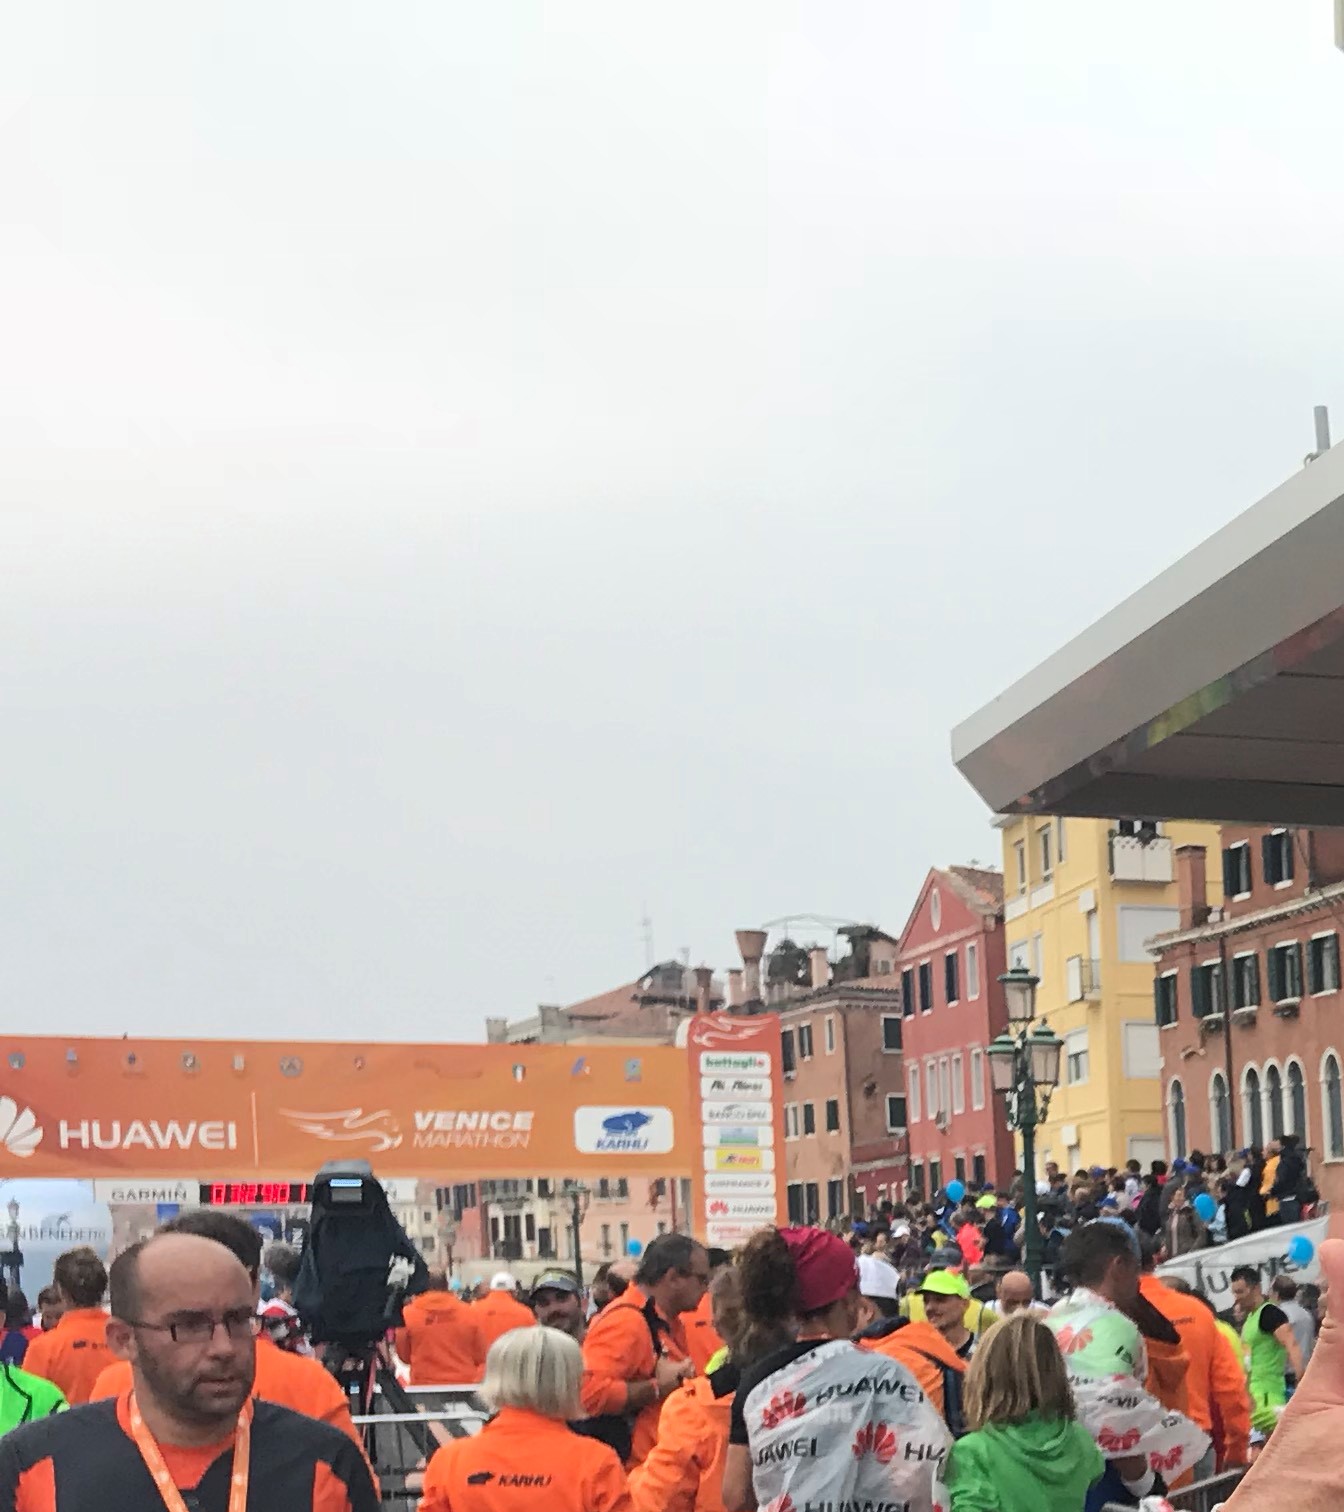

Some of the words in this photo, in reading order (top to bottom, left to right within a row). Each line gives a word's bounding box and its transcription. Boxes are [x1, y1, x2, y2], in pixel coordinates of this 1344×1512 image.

[413, 1111, 535, 1131] VENICE
[59, 1119, 238, 1150] HUAWEI
[413, 1131, 530, 1149] MARATHON
[111, 1189, 188, 1201] GARMIN
[816, 1376, 924, 1404] HUAWEI
